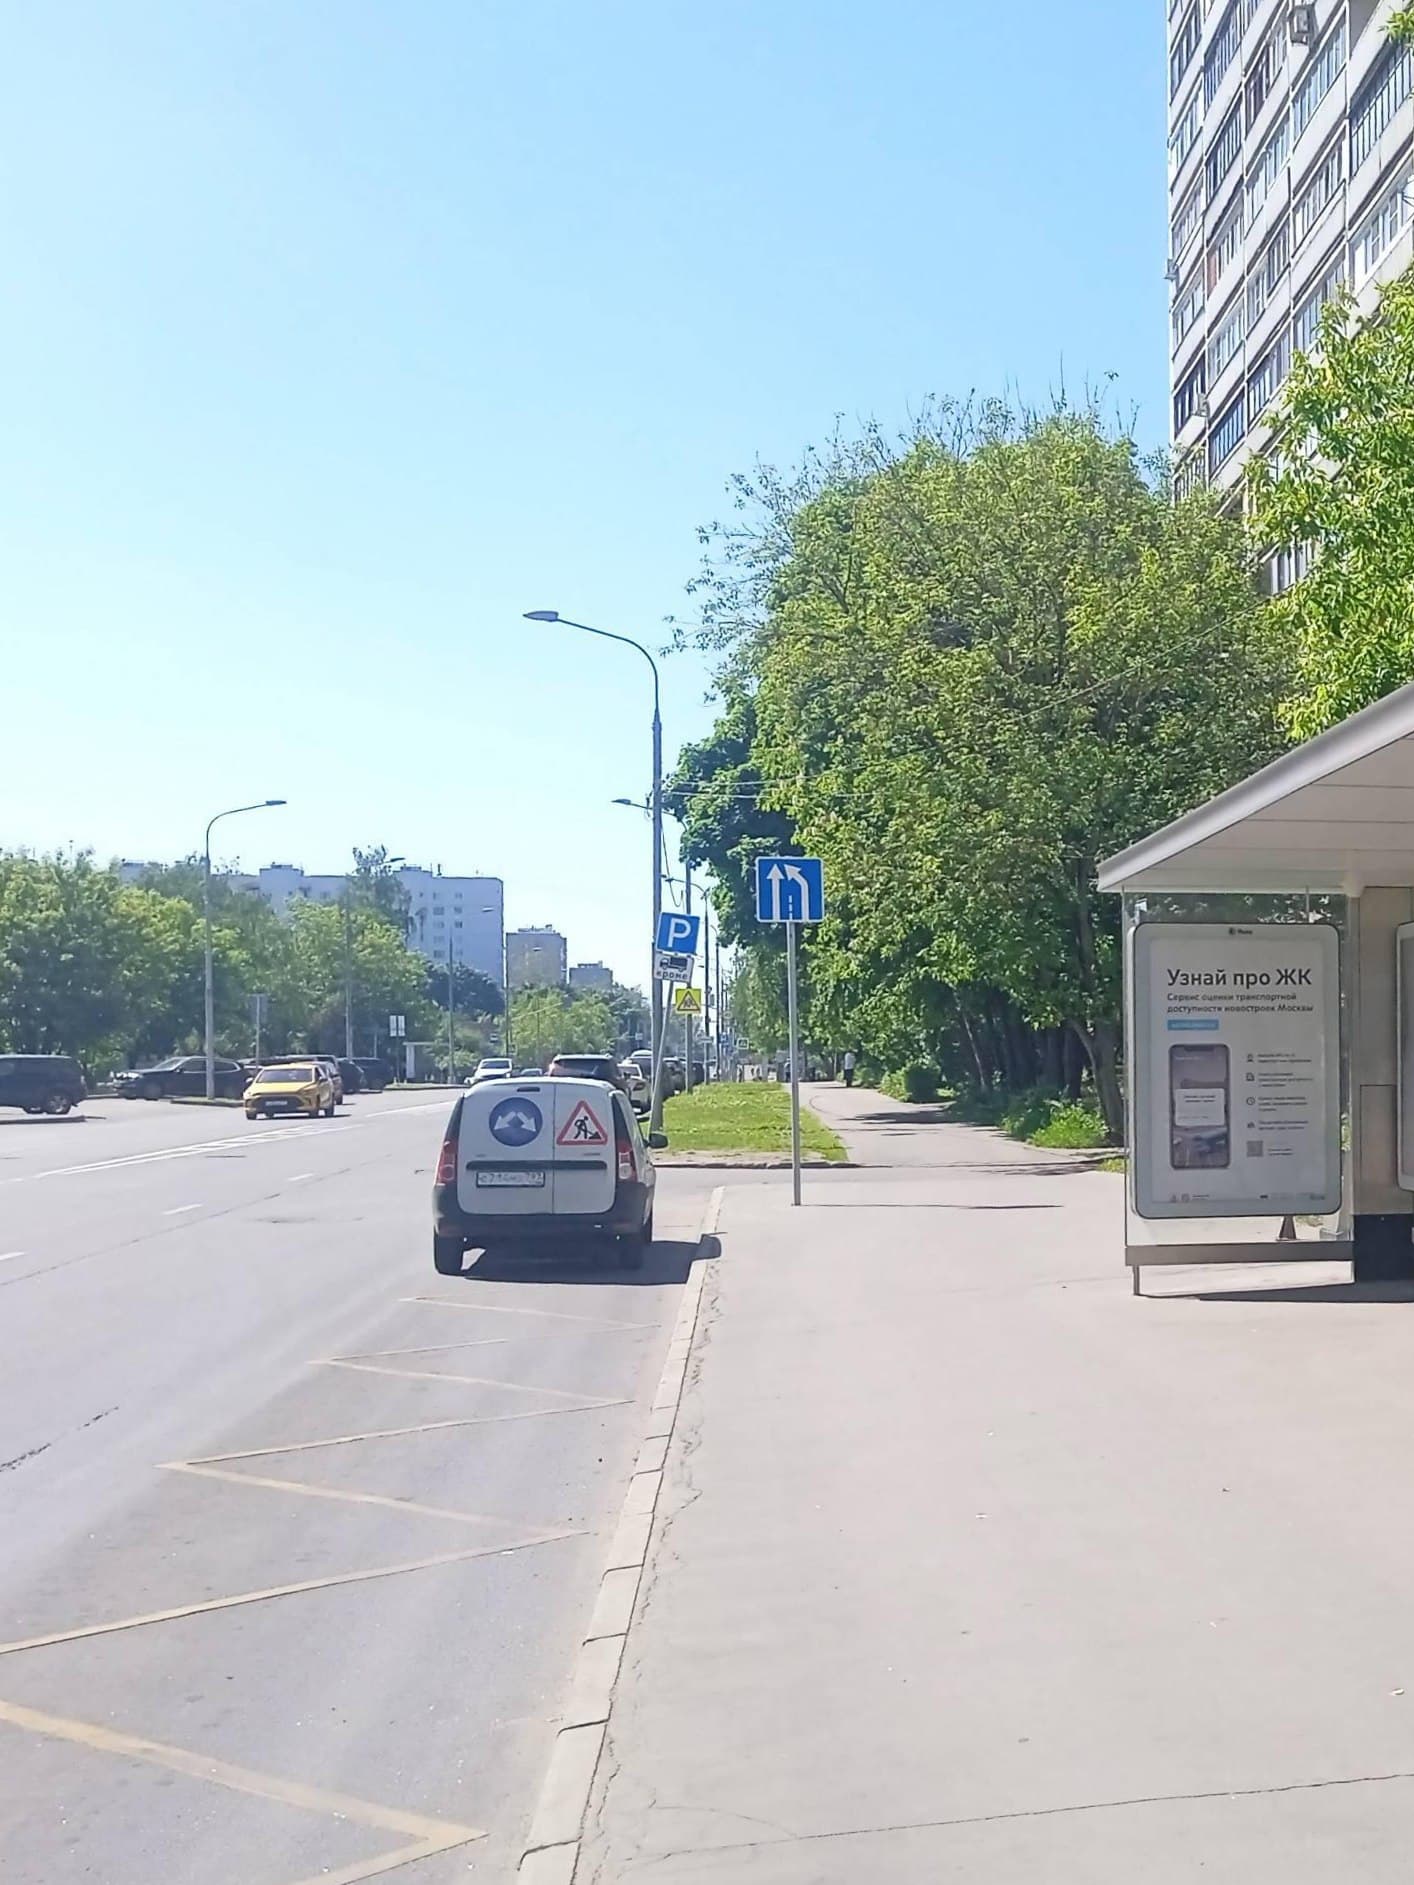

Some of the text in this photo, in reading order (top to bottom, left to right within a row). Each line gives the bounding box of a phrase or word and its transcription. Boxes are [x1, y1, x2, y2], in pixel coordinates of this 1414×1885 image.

[667, 918, 692, 948] P
[1167, 968, 1312, 989] Узнай про ЖК
[1236, 993, 1297, 1002] транспортной
